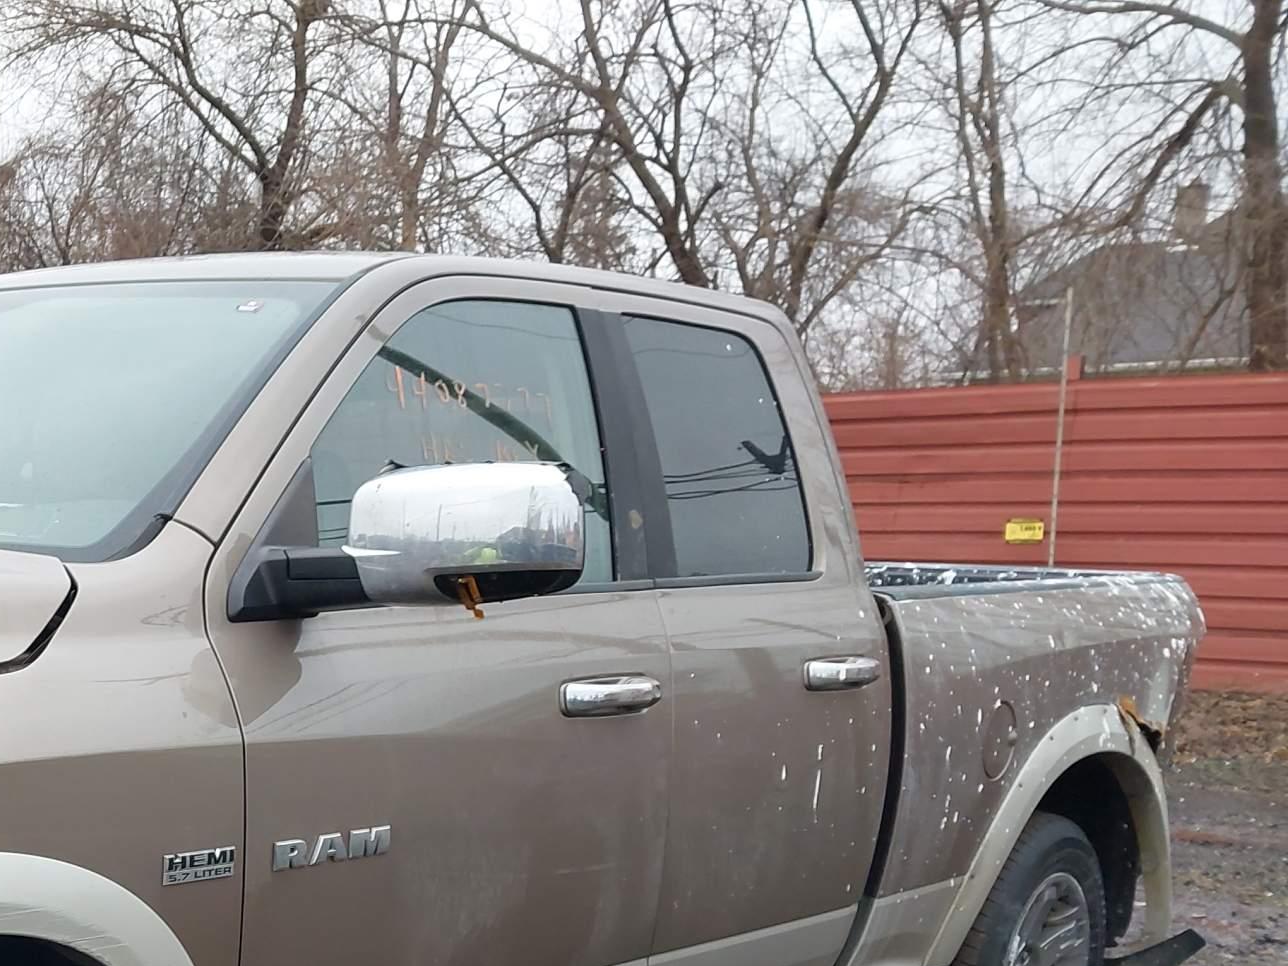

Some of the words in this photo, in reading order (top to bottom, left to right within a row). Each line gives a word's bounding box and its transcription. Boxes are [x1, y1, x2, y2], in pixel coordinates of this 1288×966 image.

[166, 848, 235, 871] HEMI
[274, 825, 391, 872] RAM
[168, 869, 190, 884] 5.7
[194, 865, 233, 880] LITER
